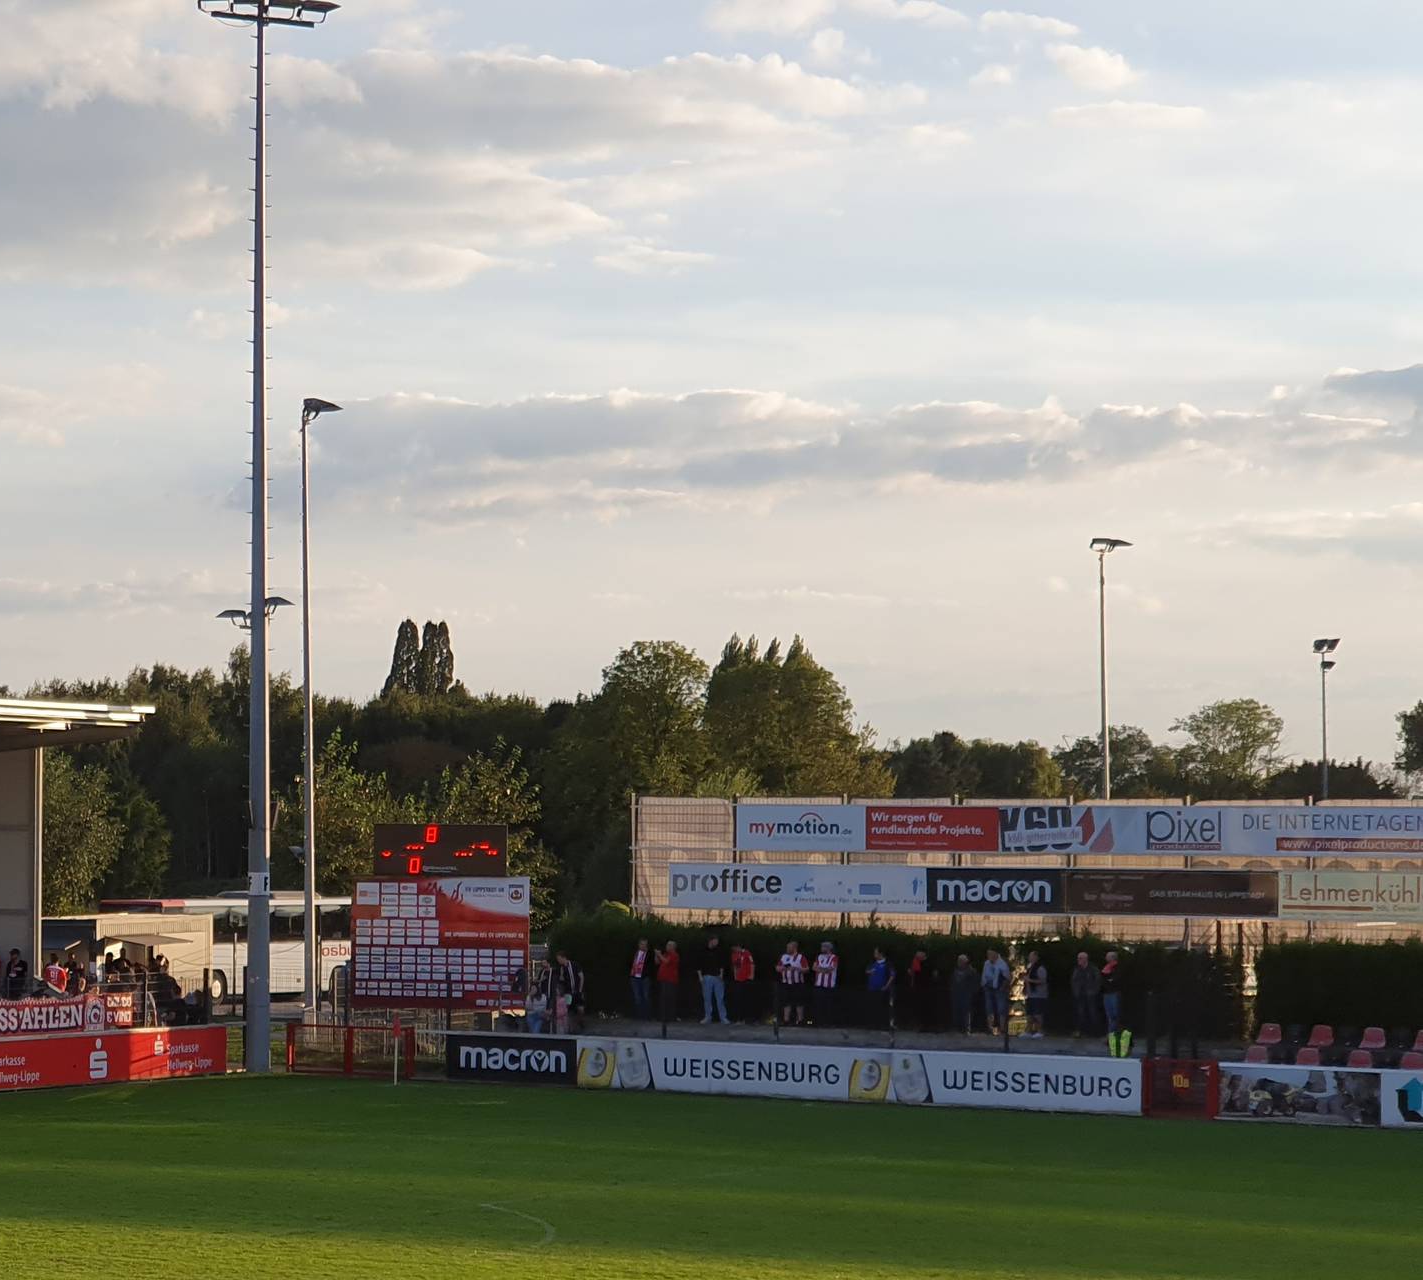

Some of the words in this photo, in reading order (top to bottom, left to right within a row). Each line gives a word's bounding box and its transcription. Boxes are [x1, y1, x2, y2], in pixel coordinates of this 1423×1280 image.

[871, 812, 890, 822] Wir
[892, 813, 926, 824] sorgen
[928, 812, 943, 822] für
[871, 824, 937, 835] rundlaufende
[939, 825, 985, 837] Projekte.
[1242, 813, 1272, 831] DIE
[672, 868, 782, 897] proffice
[936, 878, 1052, 904] macron
[20, 1004, 84, 1031] AHLEN
[166, 1042, 199, 1055] Sparkasse
[459, 1046, 567, 1073] macron
[166, 1058, 213, 1071] Hellweg-Lippe
[663, 1056, 841, 1085] WEISSENBURG
[942, 1068, 1133, 1099] WEISSENBURG
